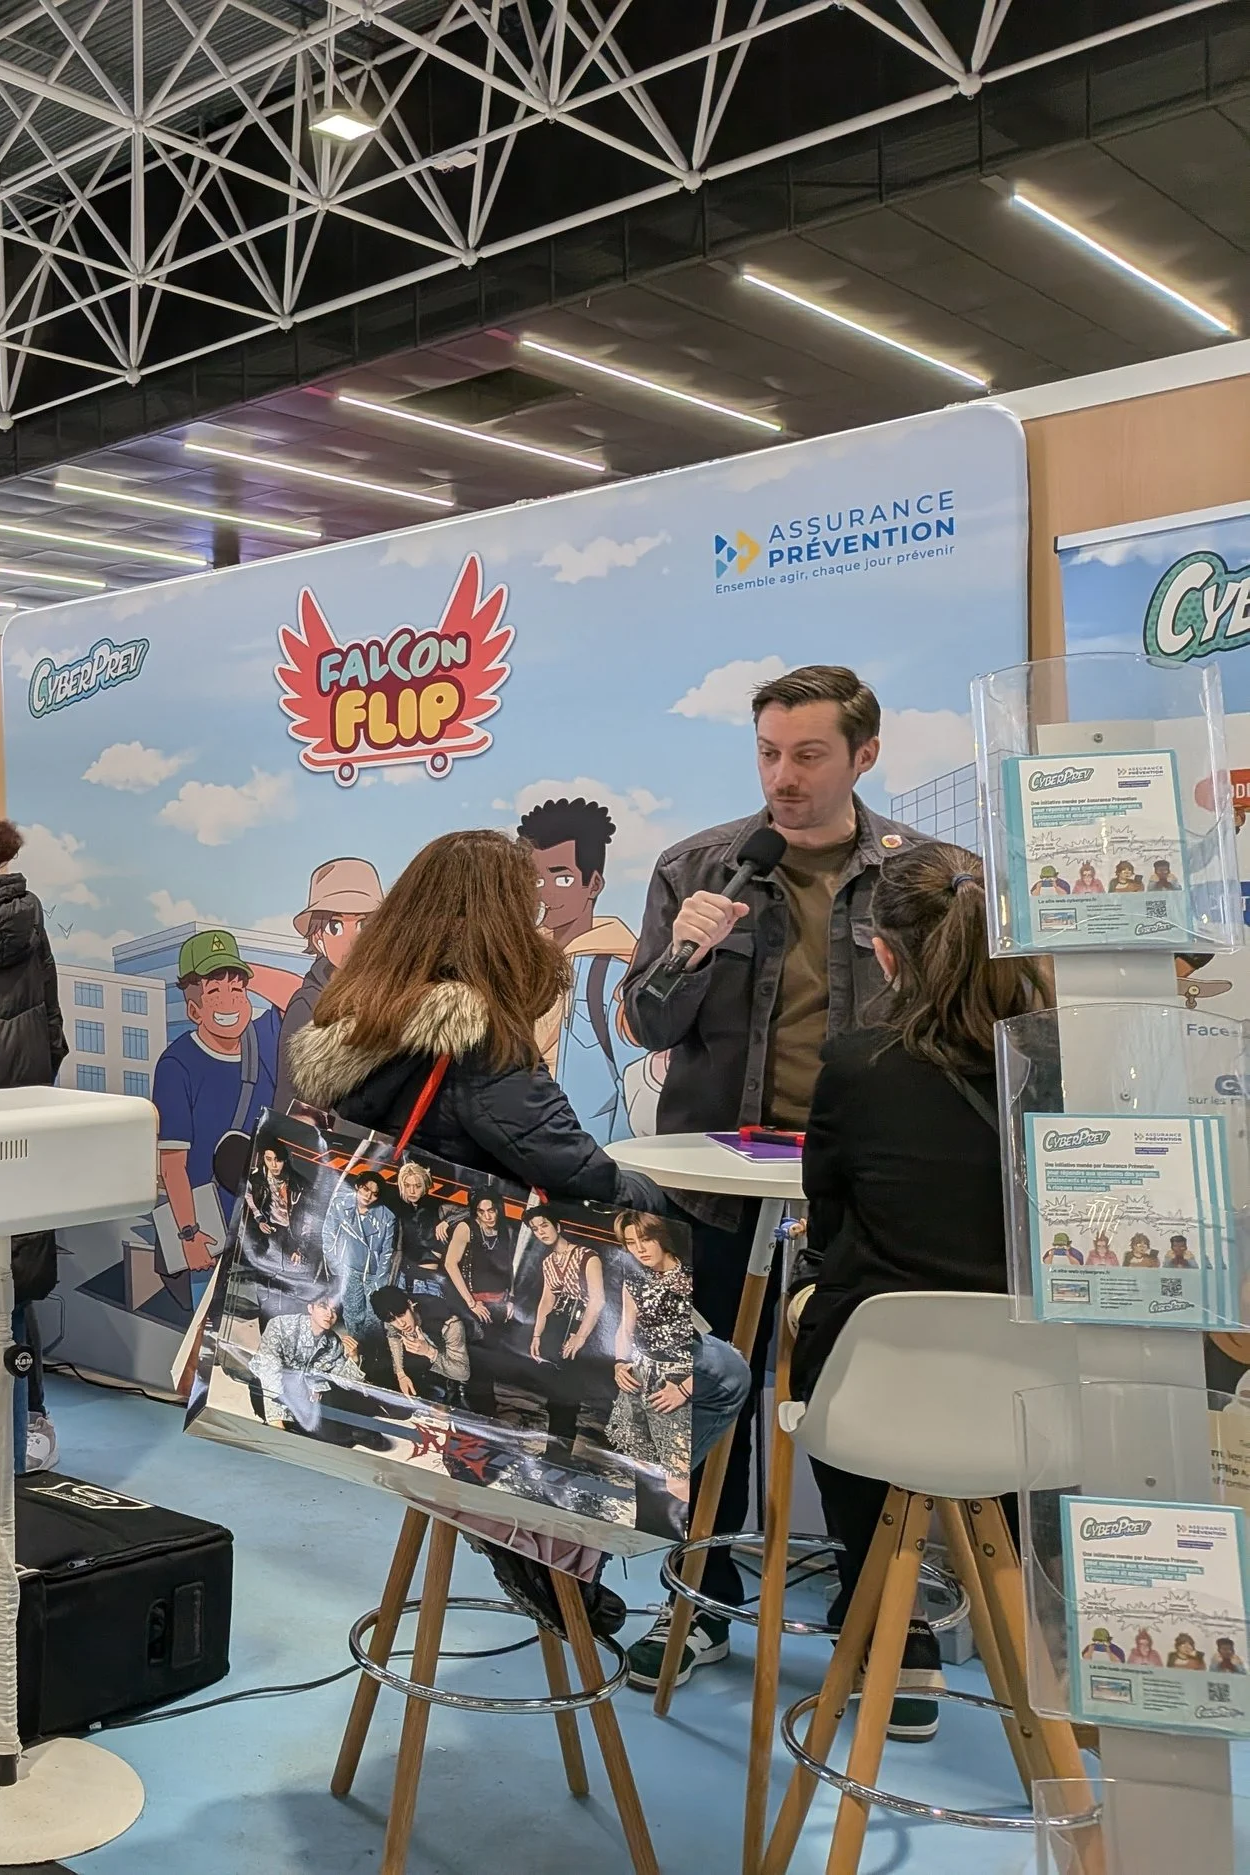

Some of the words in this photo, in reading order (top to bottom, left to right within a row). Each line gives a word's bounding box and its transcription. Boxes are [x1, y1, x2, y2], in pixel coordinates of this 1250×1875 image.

[768, 490, 954, 544] ASSURANCE
[769, 517, 955, 568] PRÉVENTION
[716, 575, 776, 594] Ensemble
[779, 570, 808, 585] agir,
[812, 561, 861, 578] chaque
[864, 555, 892, 571] jour
[897, 544, 955, 565] prévenir
[320, 633, 467, 692] FALCON
[335, 681, 460, 748] FLIP
